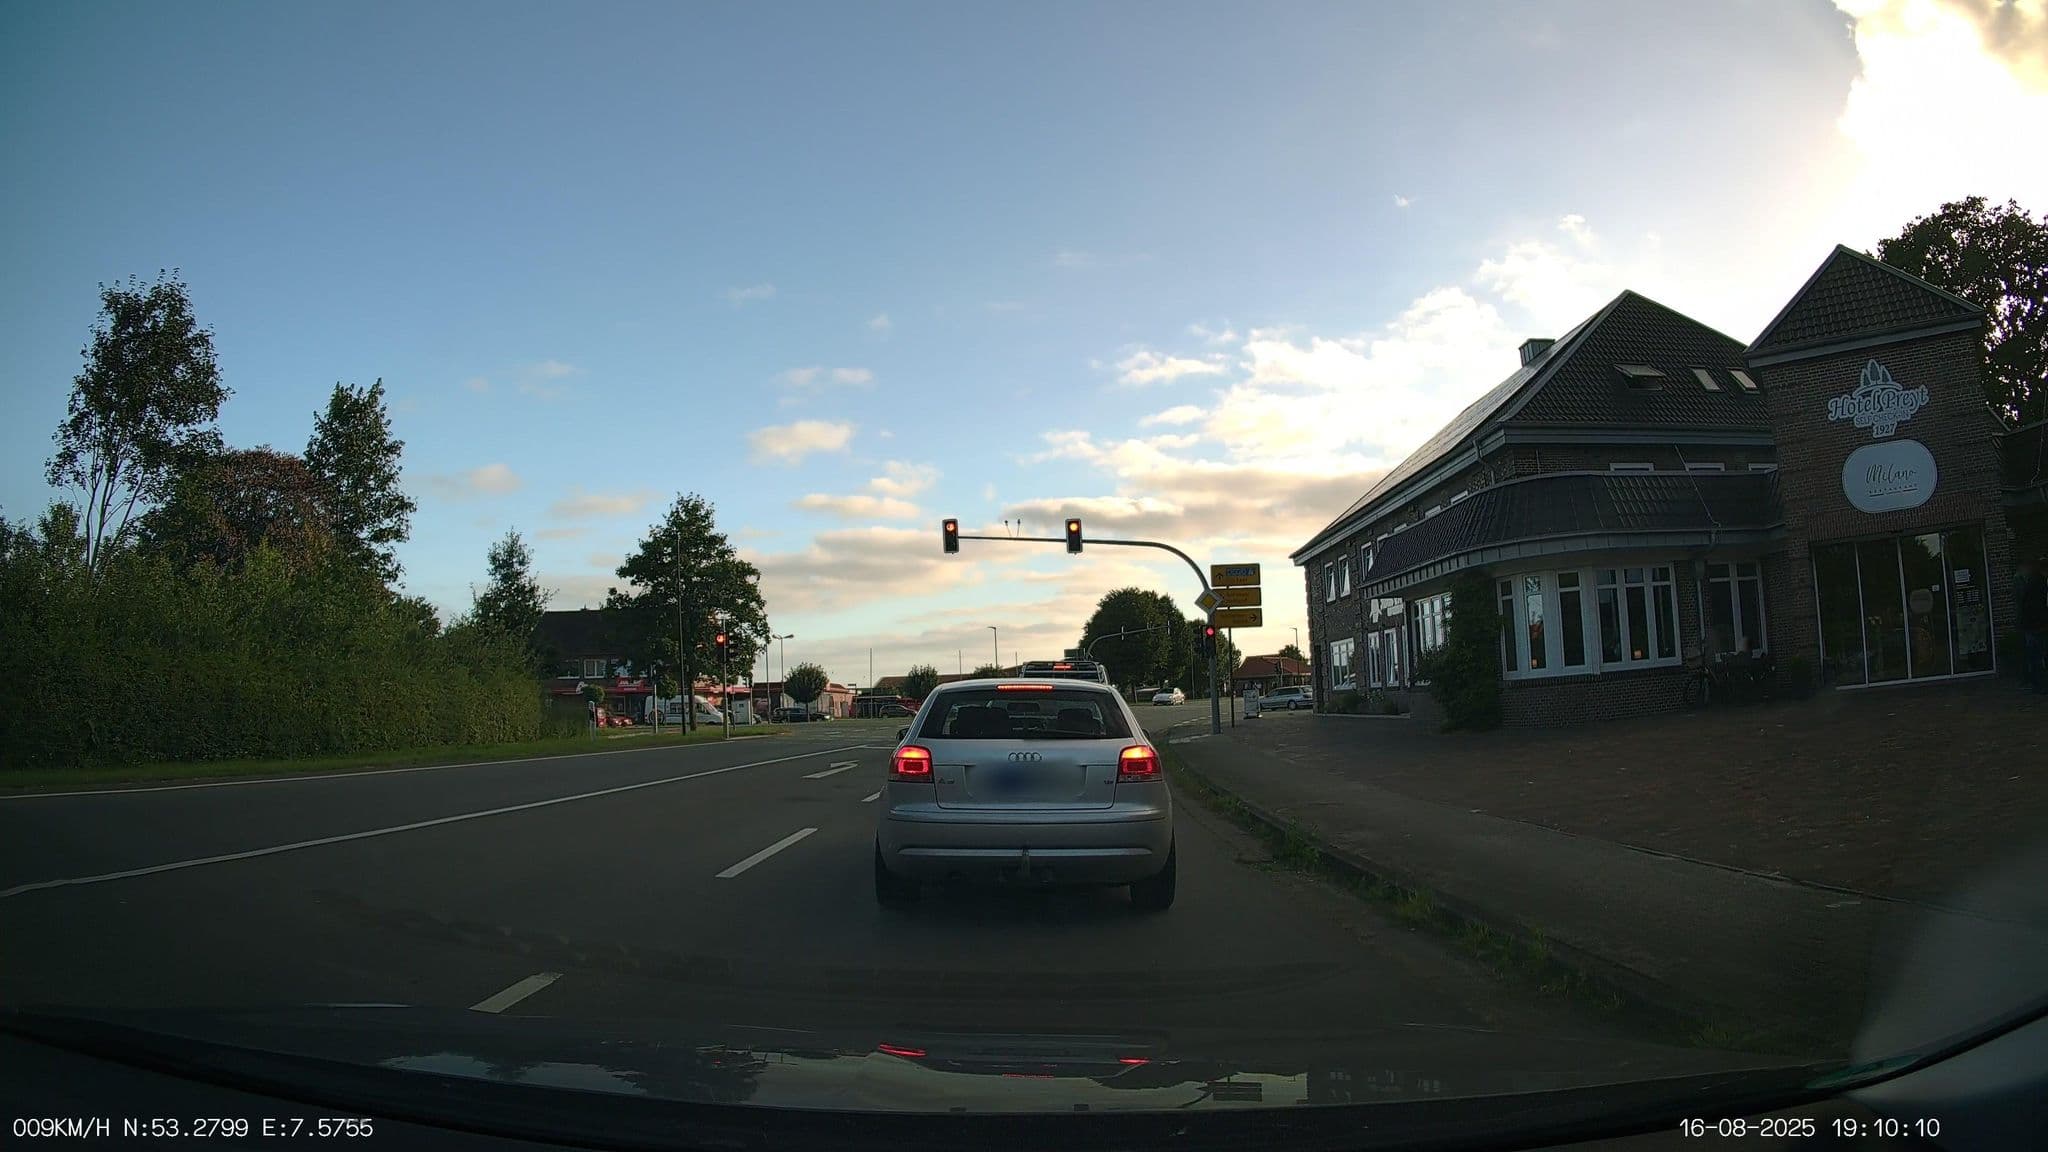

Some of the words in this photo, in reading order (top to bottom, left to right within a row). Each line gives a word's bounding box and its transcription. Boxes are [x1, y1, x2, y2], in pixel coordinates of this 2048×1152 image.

[1829, 390, 1881, 419] Hotel
[1881, 387, 1927, 413] Preyt
[1875, 423, 1896, 435] 1927
[1866, 463, 1917, 484] Milano
